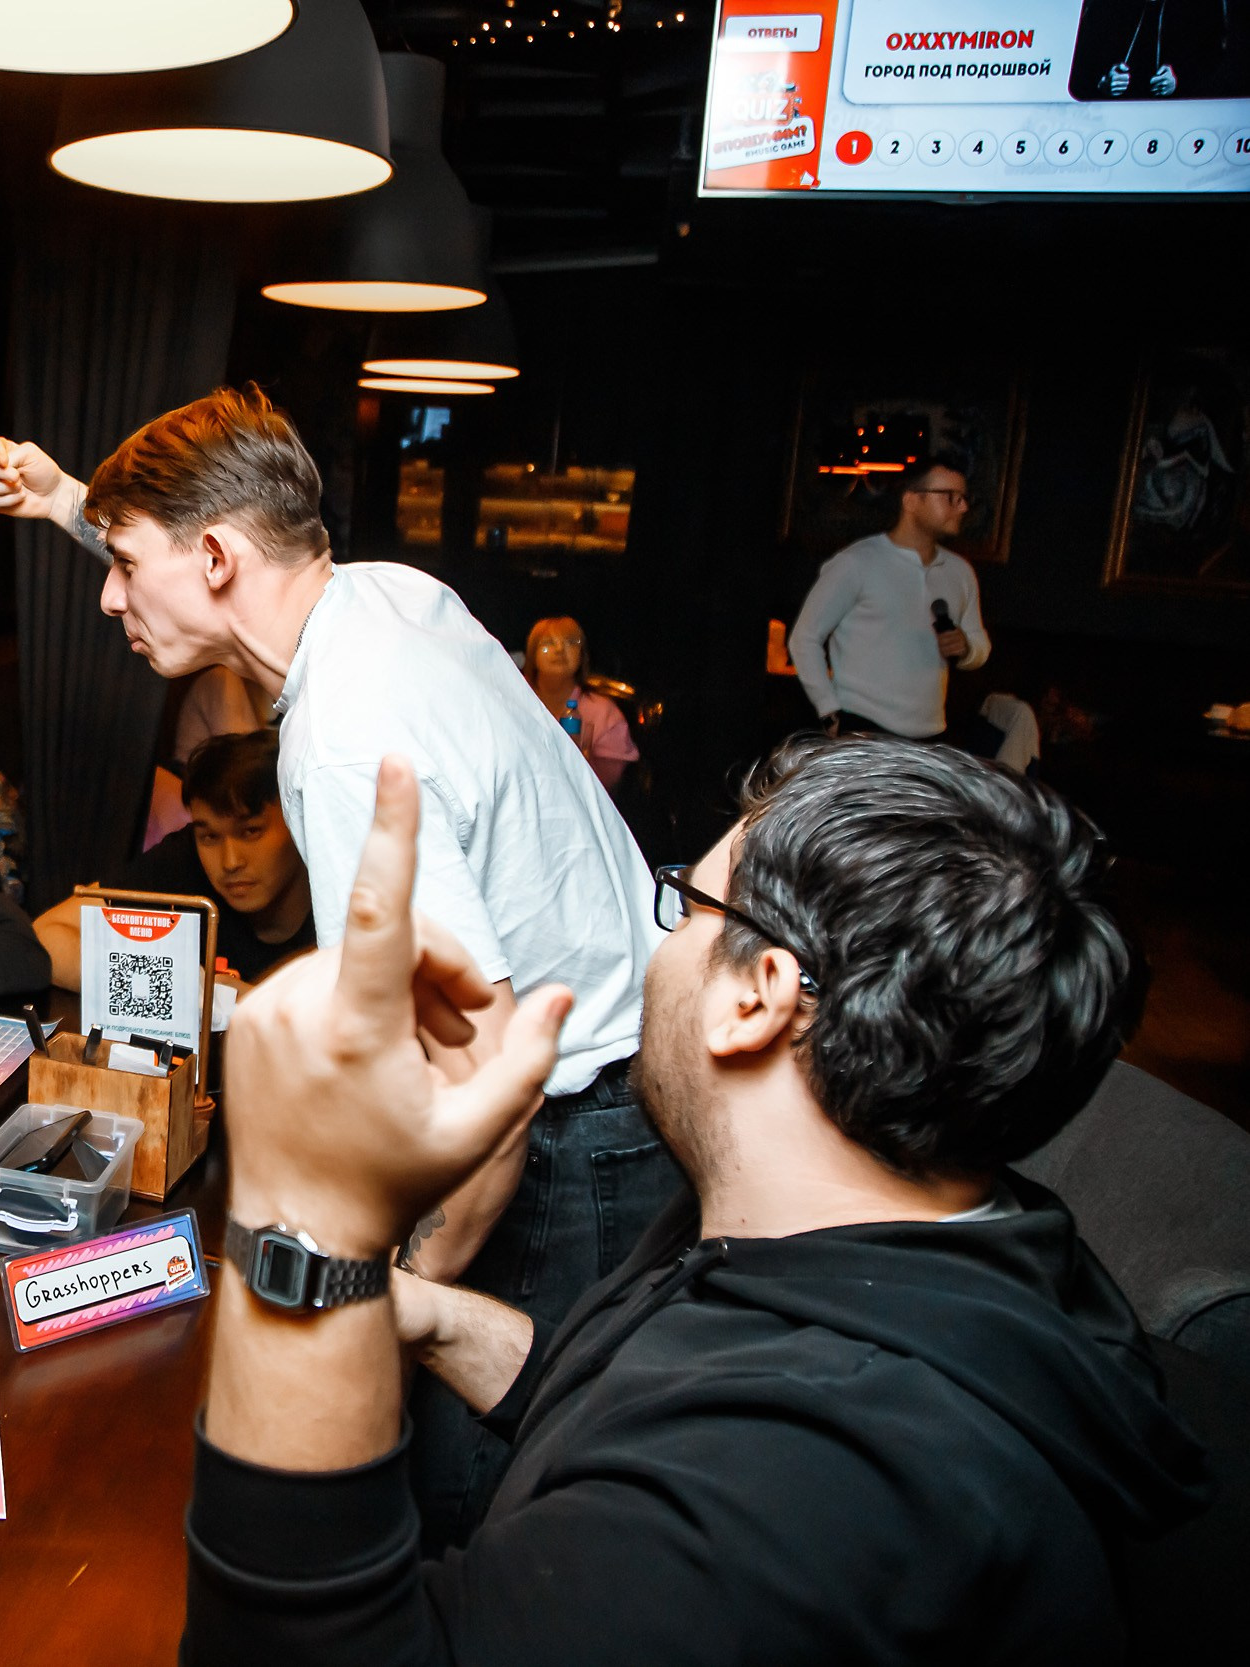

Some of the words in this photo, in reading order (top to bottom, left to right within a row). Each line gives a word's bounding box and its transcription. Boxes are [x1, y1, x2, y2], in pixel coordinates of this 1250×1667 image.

[748, 27, 798, 39] ОТВЕТЫ
[886, 29, 1035, 51] OXXXYMIRON
[864, 64, 915, 80] ГОРОД
[919, 64, 953, 80] ПОД
[955, 59, 1051, 79] ПОДОШВОЙ
[731, 97, 789, 121] QUIZ
[780, 140, 806, 152] GAME
[851, 139, 859, 155] 1
[890, 140, 900, 155] 2
[931, 140, 941, 154] 3
[973, 140, 984, 155] 4
[1015, 140, 1026, 155] 5
[1058, 140, 1069, 155] 6
[1103, 139, 1114, 155] 7
[1147, 139, 1158, 155] 8
[1193, 139, 1204, 155] 9
[129, 926, 153, 938] МЕНЮ
[169, 1262, 185, 1273] QUIZ
